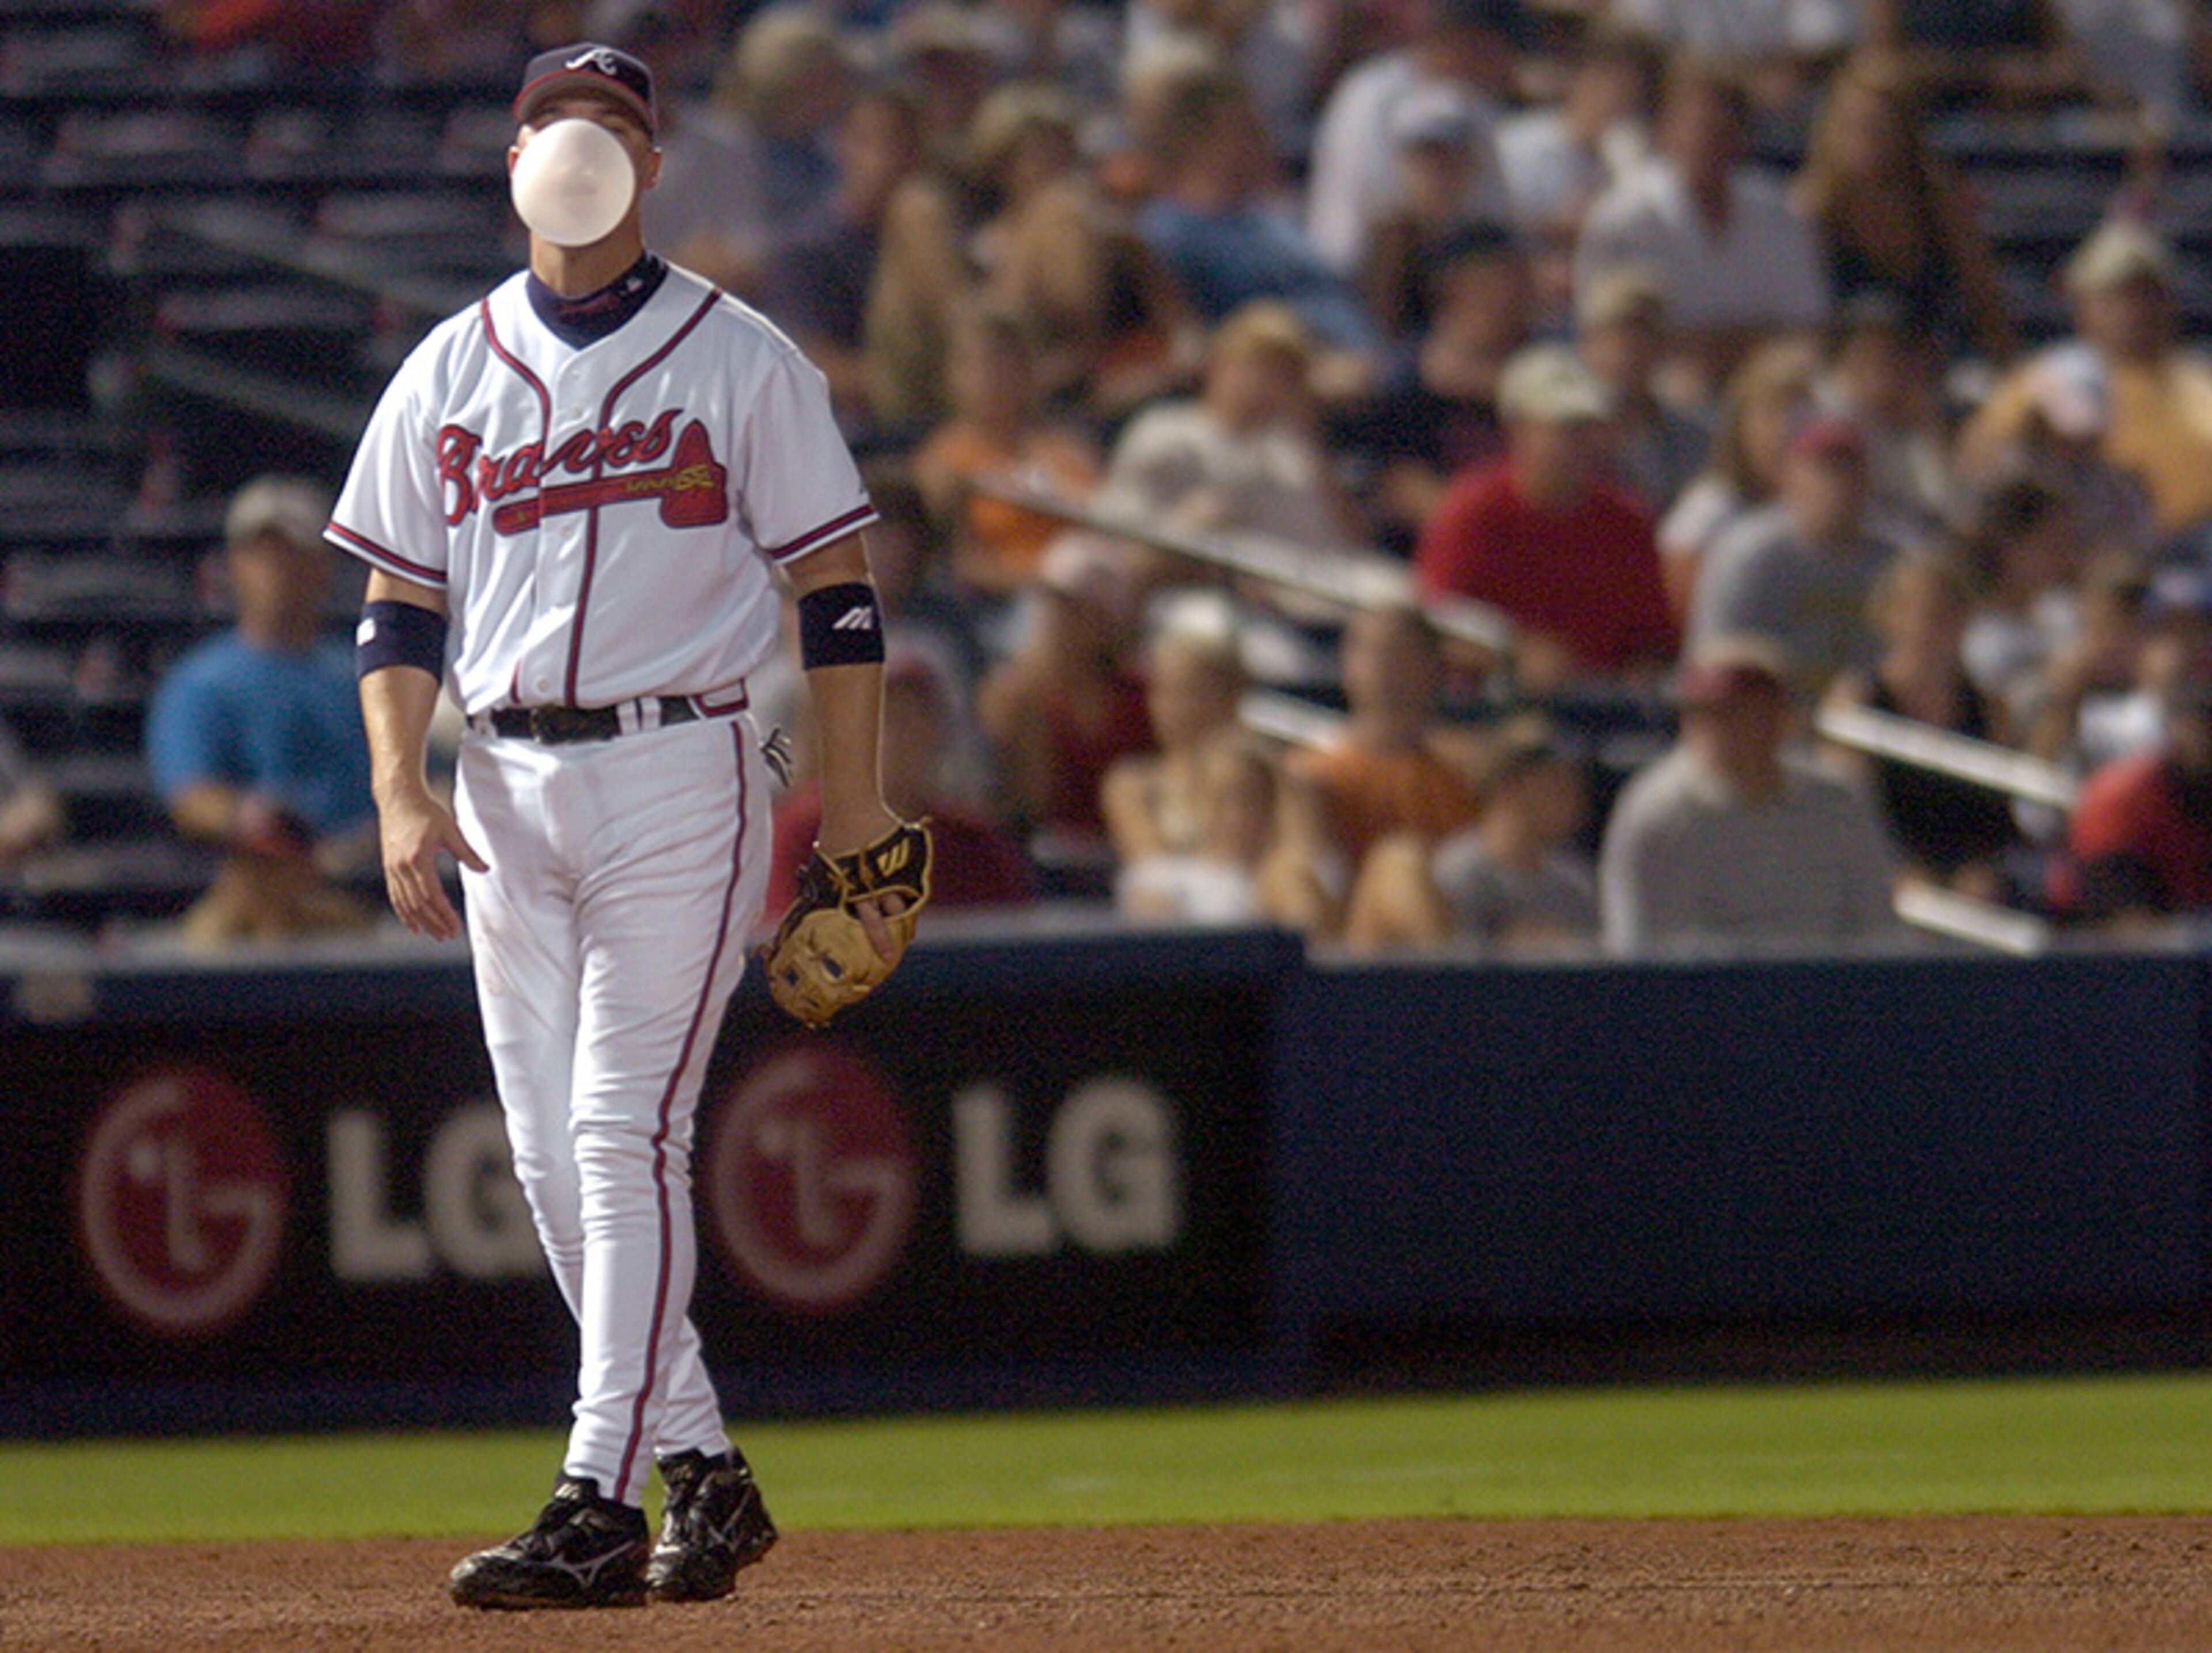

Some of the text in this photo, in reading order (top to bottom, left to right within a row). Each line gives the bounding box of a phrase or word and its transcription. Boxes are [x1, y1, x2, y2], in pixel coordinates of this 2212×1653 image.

[437, 407, 683, 526] Braves
[327, 1104, 547, 1280] LG
[952, 1078, 1179, 1256] LG
